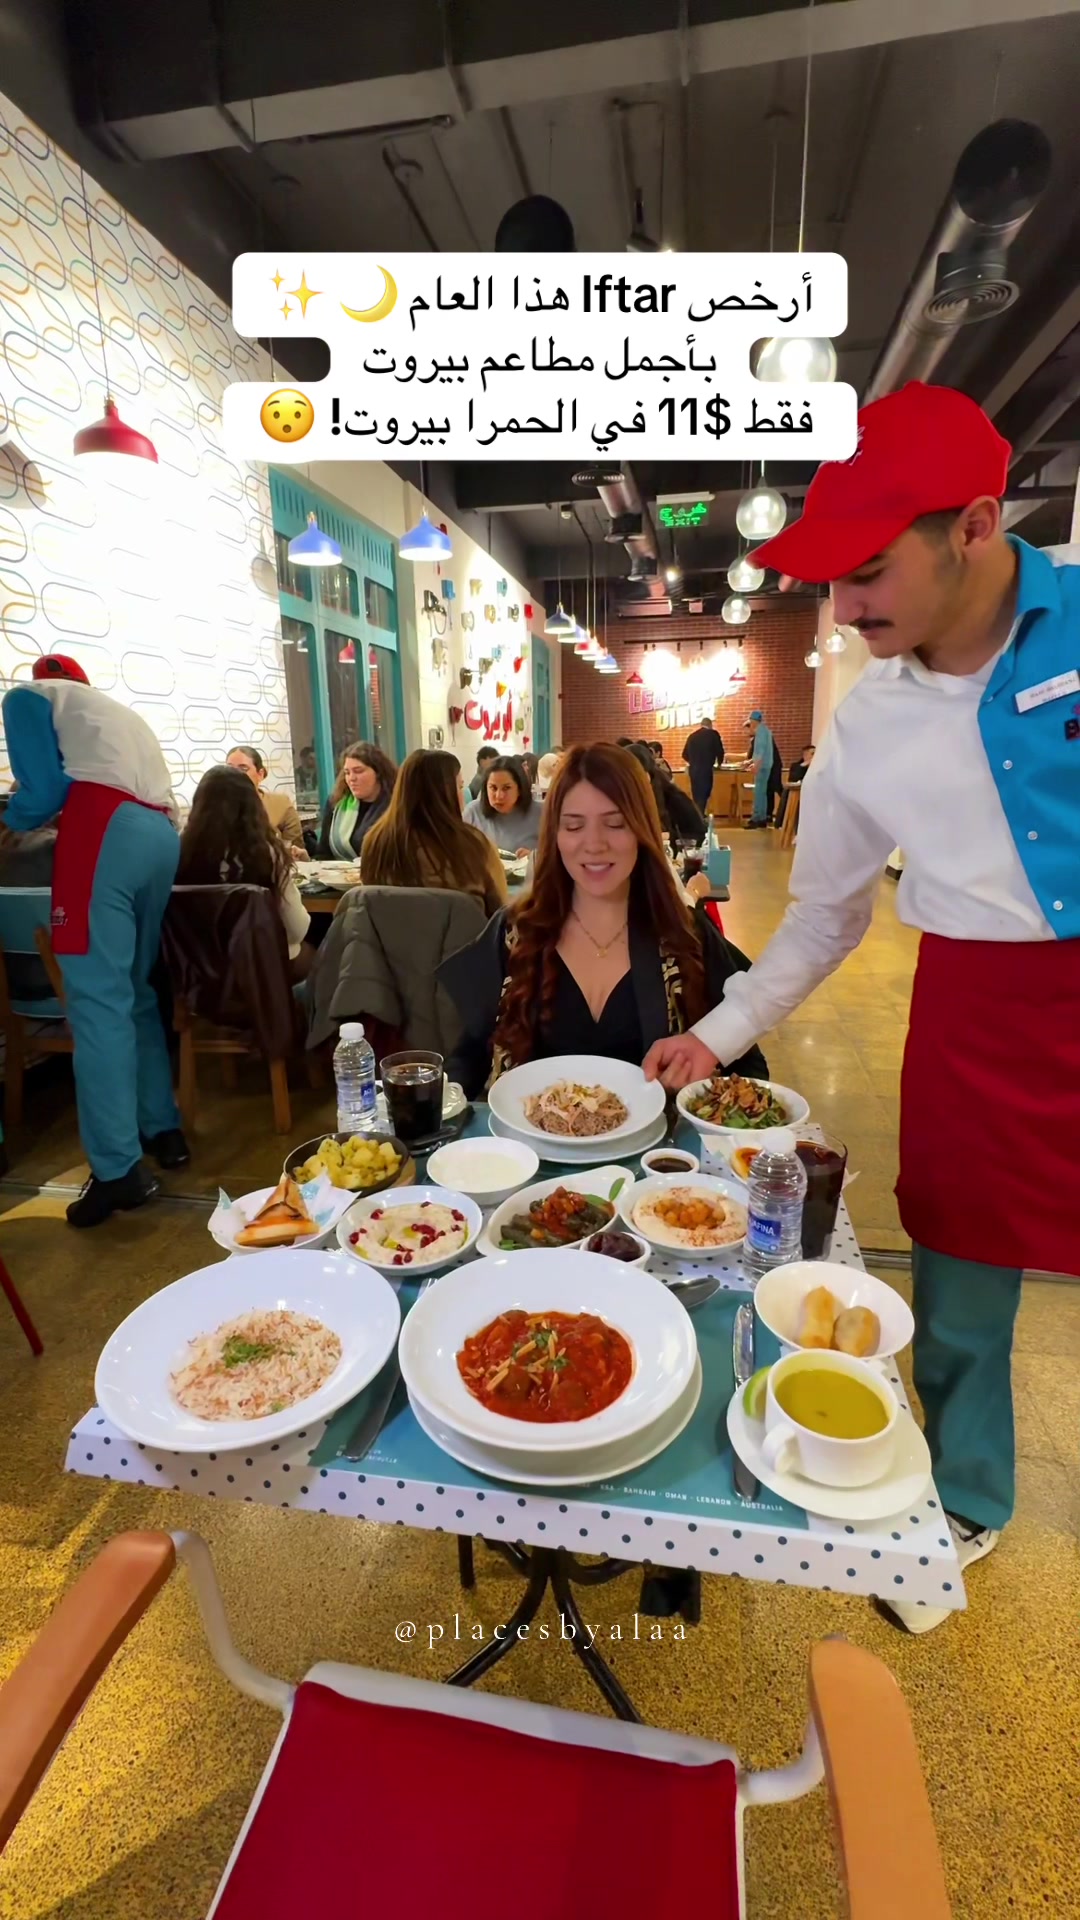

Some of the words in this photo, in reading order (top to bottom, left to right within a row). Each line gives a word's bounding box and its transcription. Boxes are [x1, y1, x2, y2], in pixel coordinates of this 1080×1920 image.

[664, 516, 701, 527] EXIT
[623, 1485, 657, 1497] BAHRAIN
[664, 1491, 688, 1501] OMAN
[696, 1495, 732, 1507] LEBANON
[740, 1500, 784, 1512] AUSTRALIA
